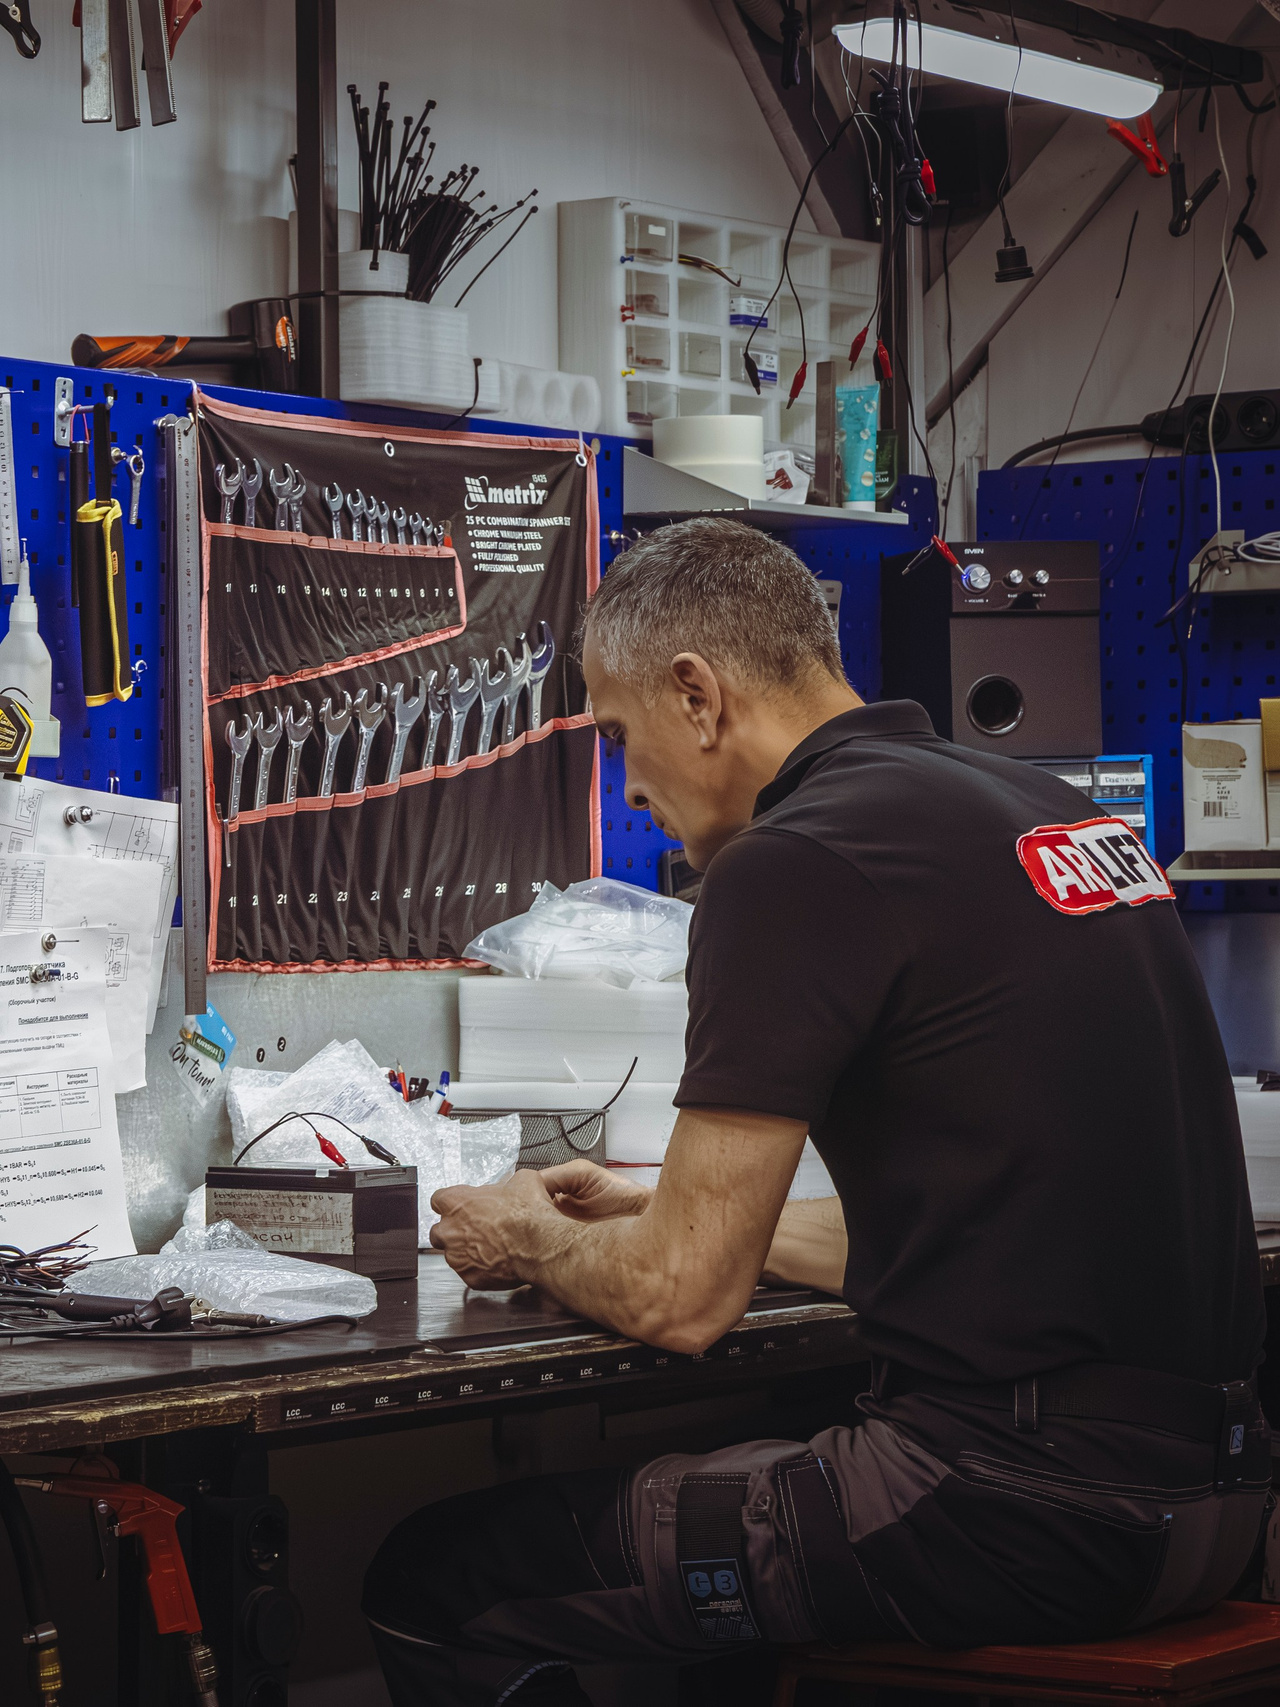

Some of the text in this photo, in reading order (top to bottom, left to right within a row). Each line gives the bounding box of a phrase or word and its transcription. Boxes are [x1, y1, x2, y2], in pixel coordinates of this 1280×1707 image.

[487, 483, 546, 505] matrix
[465, 516, 475, 525] 25
[475, 516, 486, 525] PC
[529, 516, 564, 527] SPANNER
[473, 530, 500, 538] CHROME
[523, 531, 544, 540] STEEL
[475, 541, 498, 550] BRIGHT
[517, 543, 542, 551] PLATED
[477, 552, 494, 560] FULLY
[516, 563, 545, 574] QUALITY
[277, 585, 286, 594] 16
[321, 587, 331, 597] 14
[357, 587, 367, 597] 12
[405, 588, 411, 598] 9
[434, 588, 439, 597] 7
[448, 588, 454, 597] 6
[1037, 834, 1163, 902] ARLIFT
[495, 882, 507, 894] 28
[531, 882, 541, 893] 30
[276, 893, 287, 905] 21
[336, 891, 348, 902] 23
[16, 977, 29, 985] SMC
[278, 1040, 284, 1049] 2
[259, 1051, 264, 1060] 1
[618, 1362, 631, 1370] LCC
[580, 1368, 593, 1376] LCC
[541, 1373, 554, 1381] LCC
[501, 1379, 514, 1387] LCC
[460, 1384, 473, 1392] LCC
[418, 1390, 432, 1399] LCC
[375, 1396, 389, 1404] LCC
[331, 1402, 345, 1411] LCC
[286, 1408, 301, 1417] LCC
